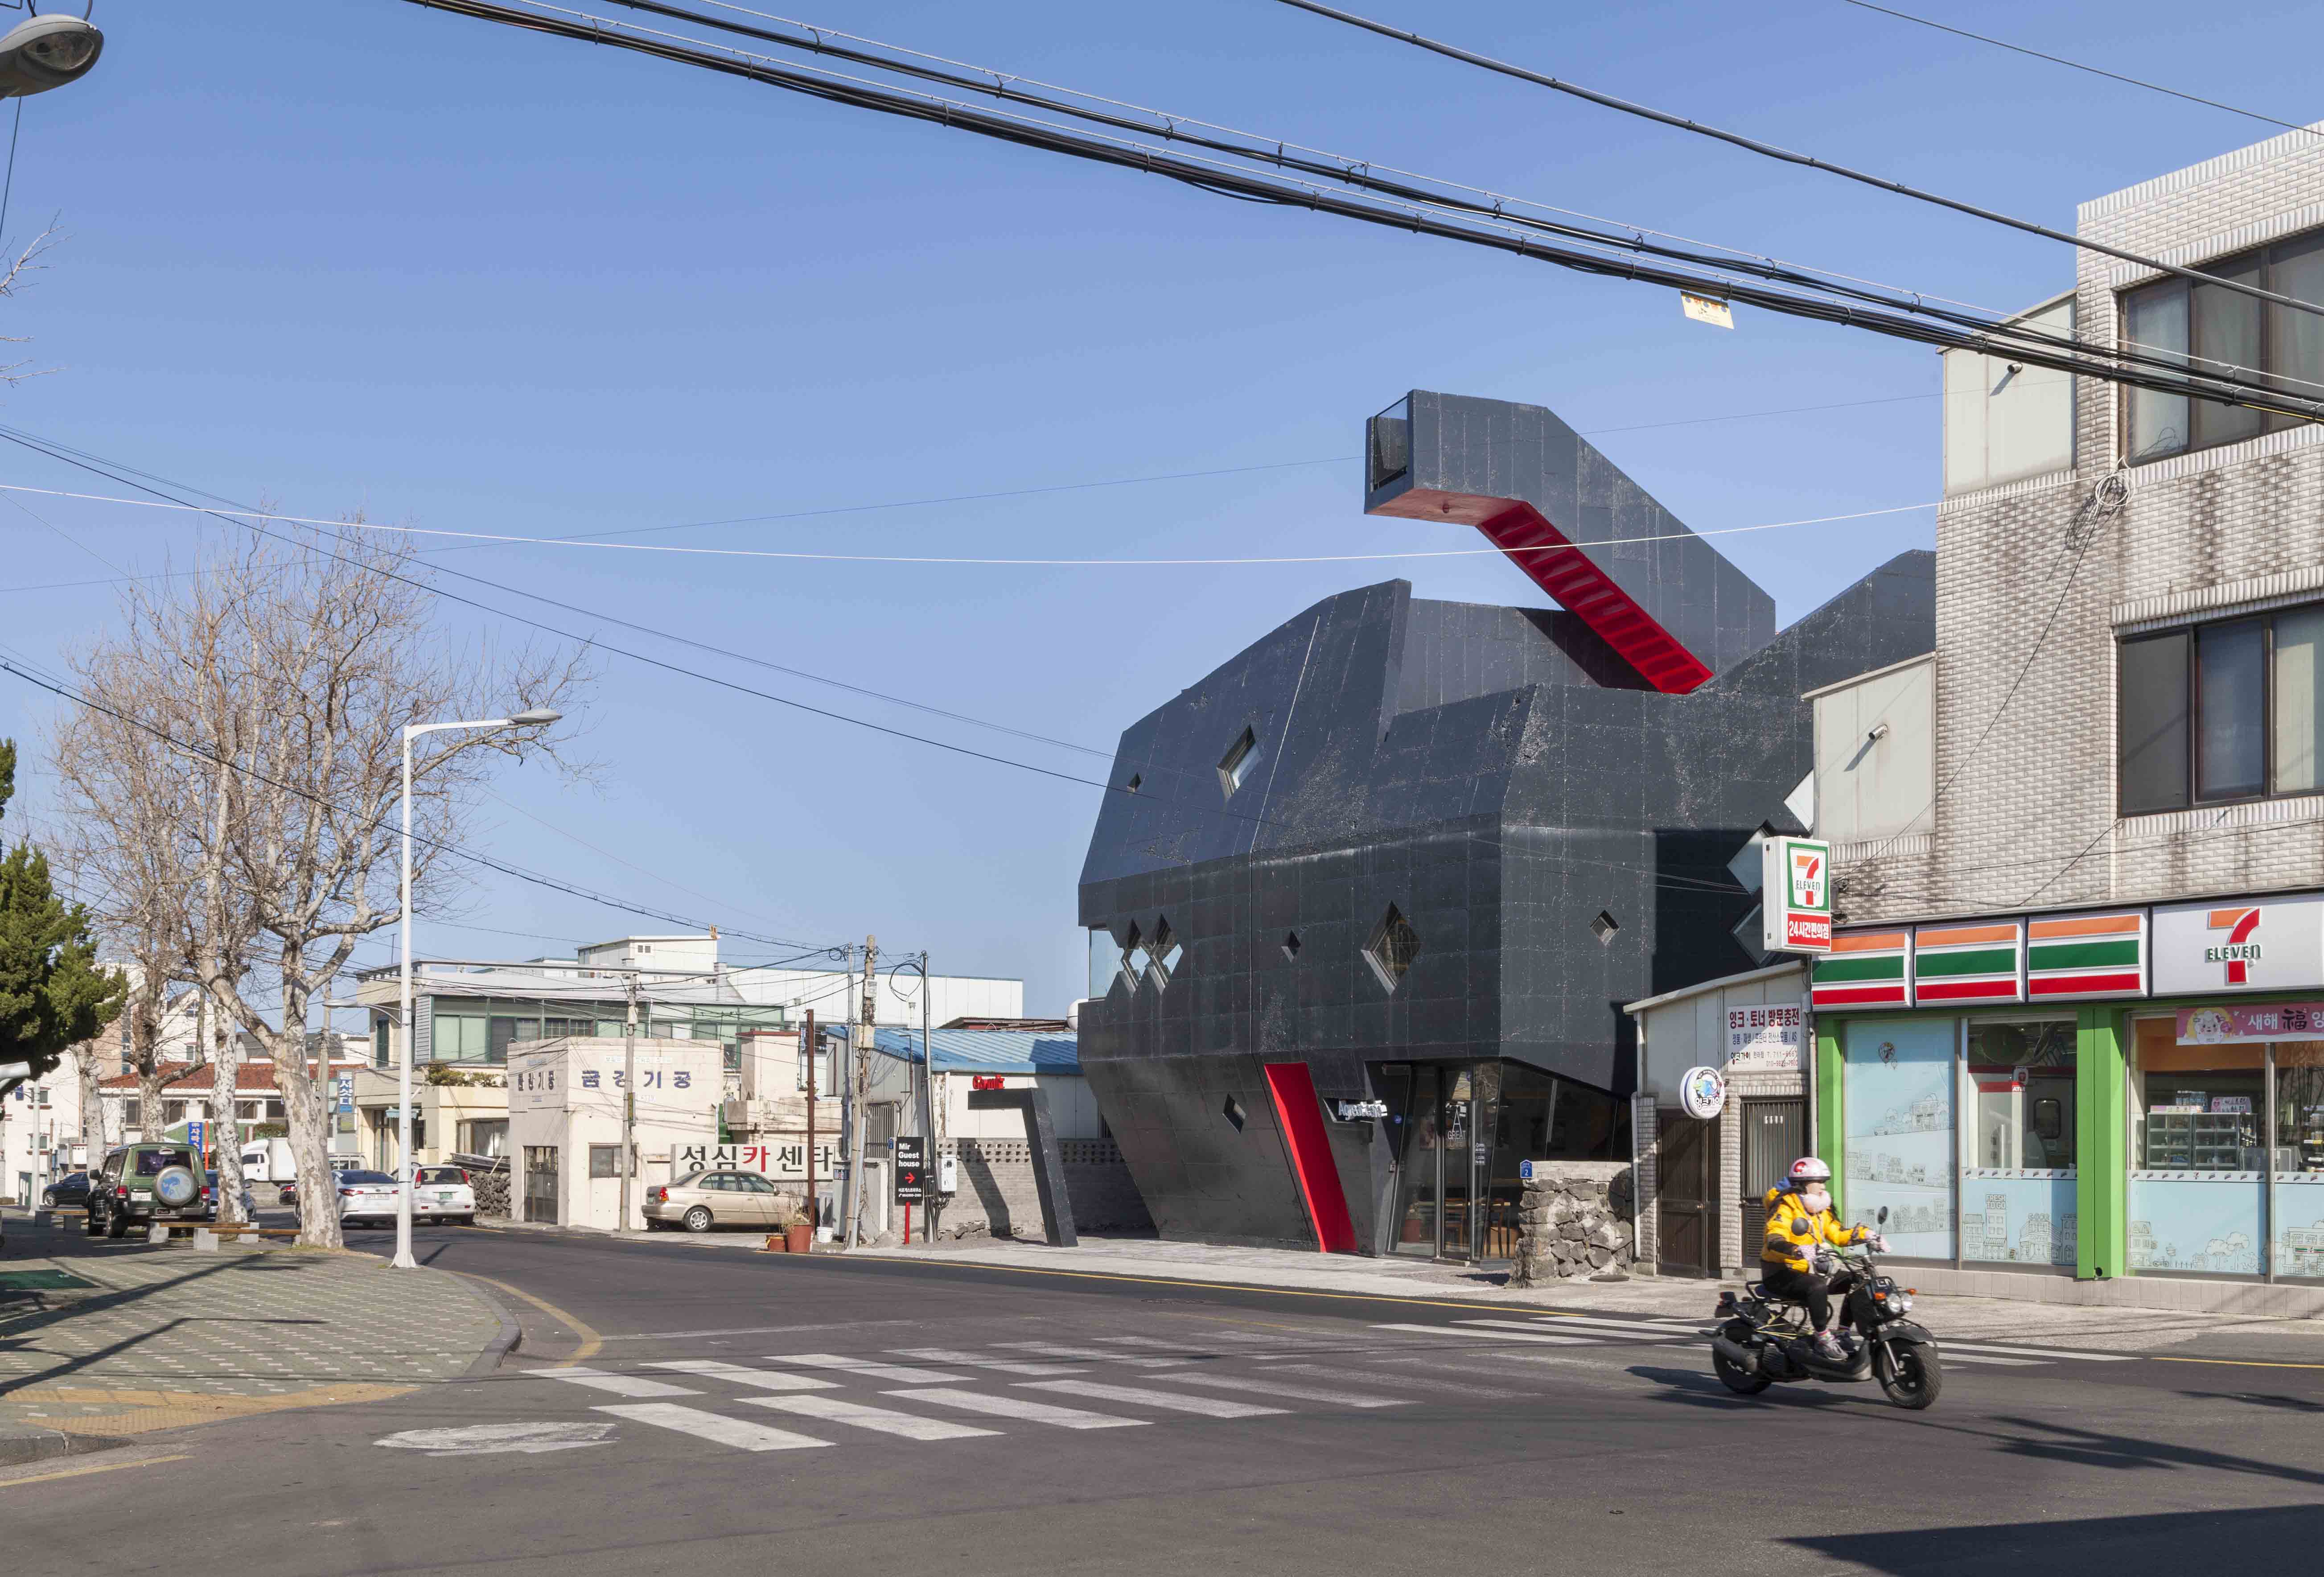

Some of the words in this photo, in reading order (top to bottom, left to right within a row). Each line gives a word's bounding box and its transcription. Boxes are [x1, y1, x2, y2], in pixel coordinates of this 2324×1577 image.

[1789, 921, 1829, 939] 24시간편의점
[1730, 1011, 1744, 1029] 잉크
[1751, 1010, 1765, 1027] 토너
[1769, 1008, 1799, 1027] 방문충전
[2247, 1013, 2278, 1030] 새해
[2282, 1008, 2308, 1031] 福
[1448, 1130, 1466, 1140] GREAT
[680, 1146, 833, 1172] 성심카센타
